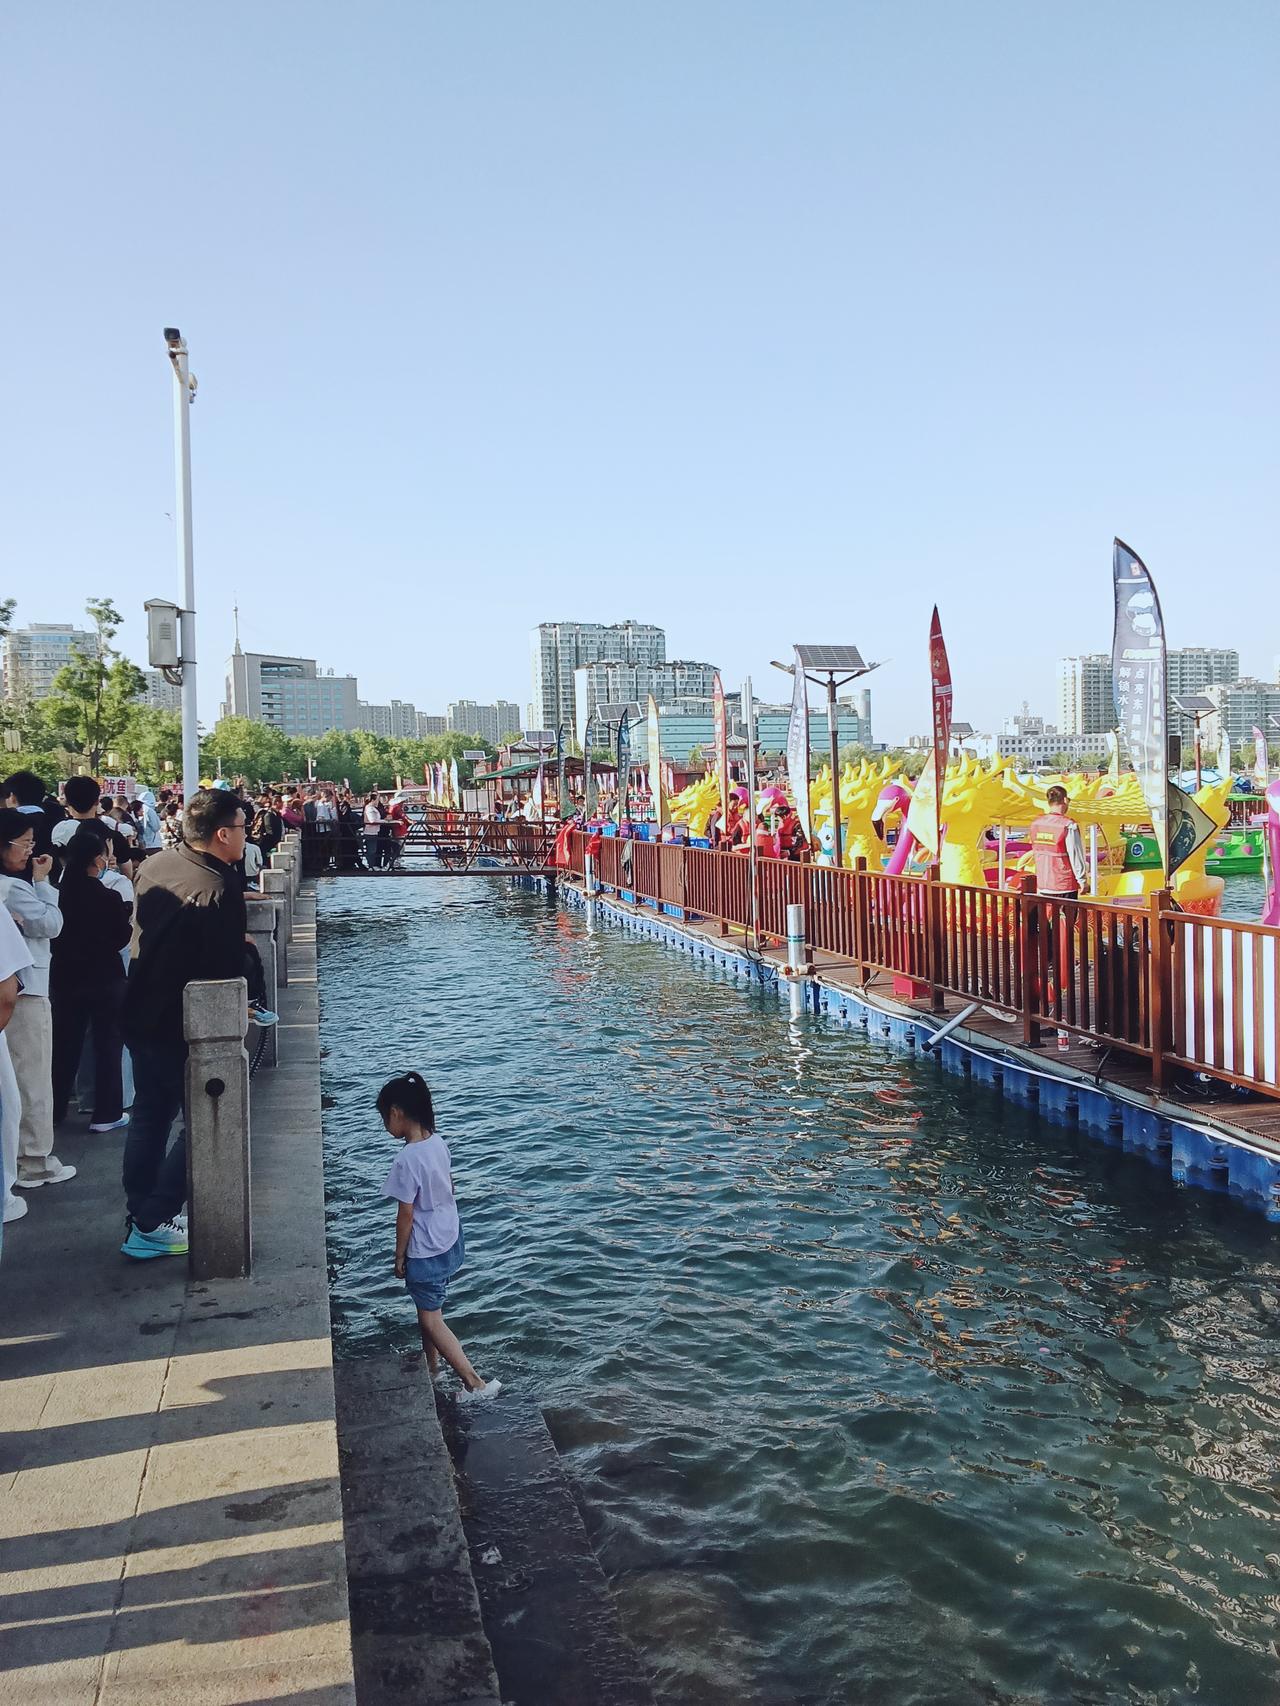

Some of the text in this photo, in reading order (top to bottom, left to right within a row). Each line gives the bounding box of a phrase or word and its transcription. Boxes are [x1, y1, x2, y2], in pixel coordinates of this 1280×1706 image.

[1117, 667, 1131, 747] 解锁水上古
